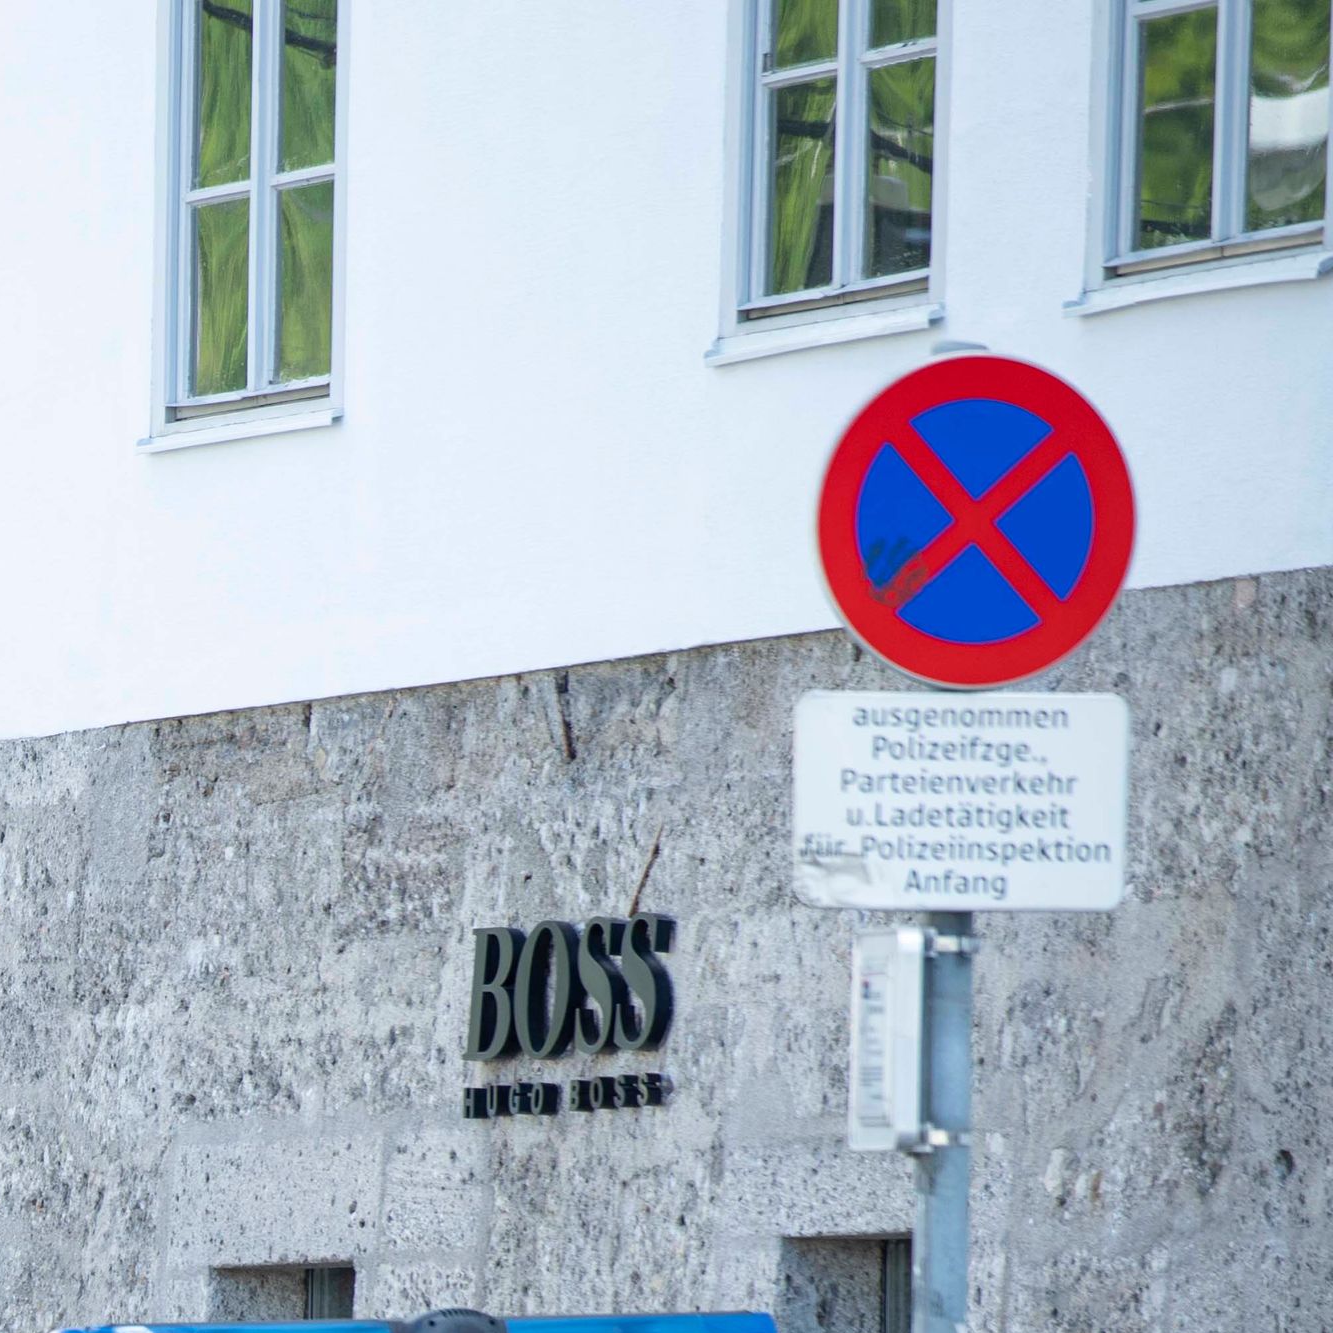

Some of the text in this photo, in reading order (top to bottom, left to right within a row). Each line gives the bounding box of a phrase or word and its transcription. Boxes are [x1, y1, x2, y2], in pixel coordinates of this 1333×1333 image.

[852, 706, 1070, 732] ausgenommen
[840, 769, 1079, 796] Parteienverkehr
[845, 802, 1071, 833] u.Ladetätigkeit
[799, 834, 1112, 865] für Polizeiinspektion
[904, 870, 1009, 899] Anfang
[462, 912, 676, 1061] BOSS
[464, 1072, 663, 1119] HUGO BOSS
